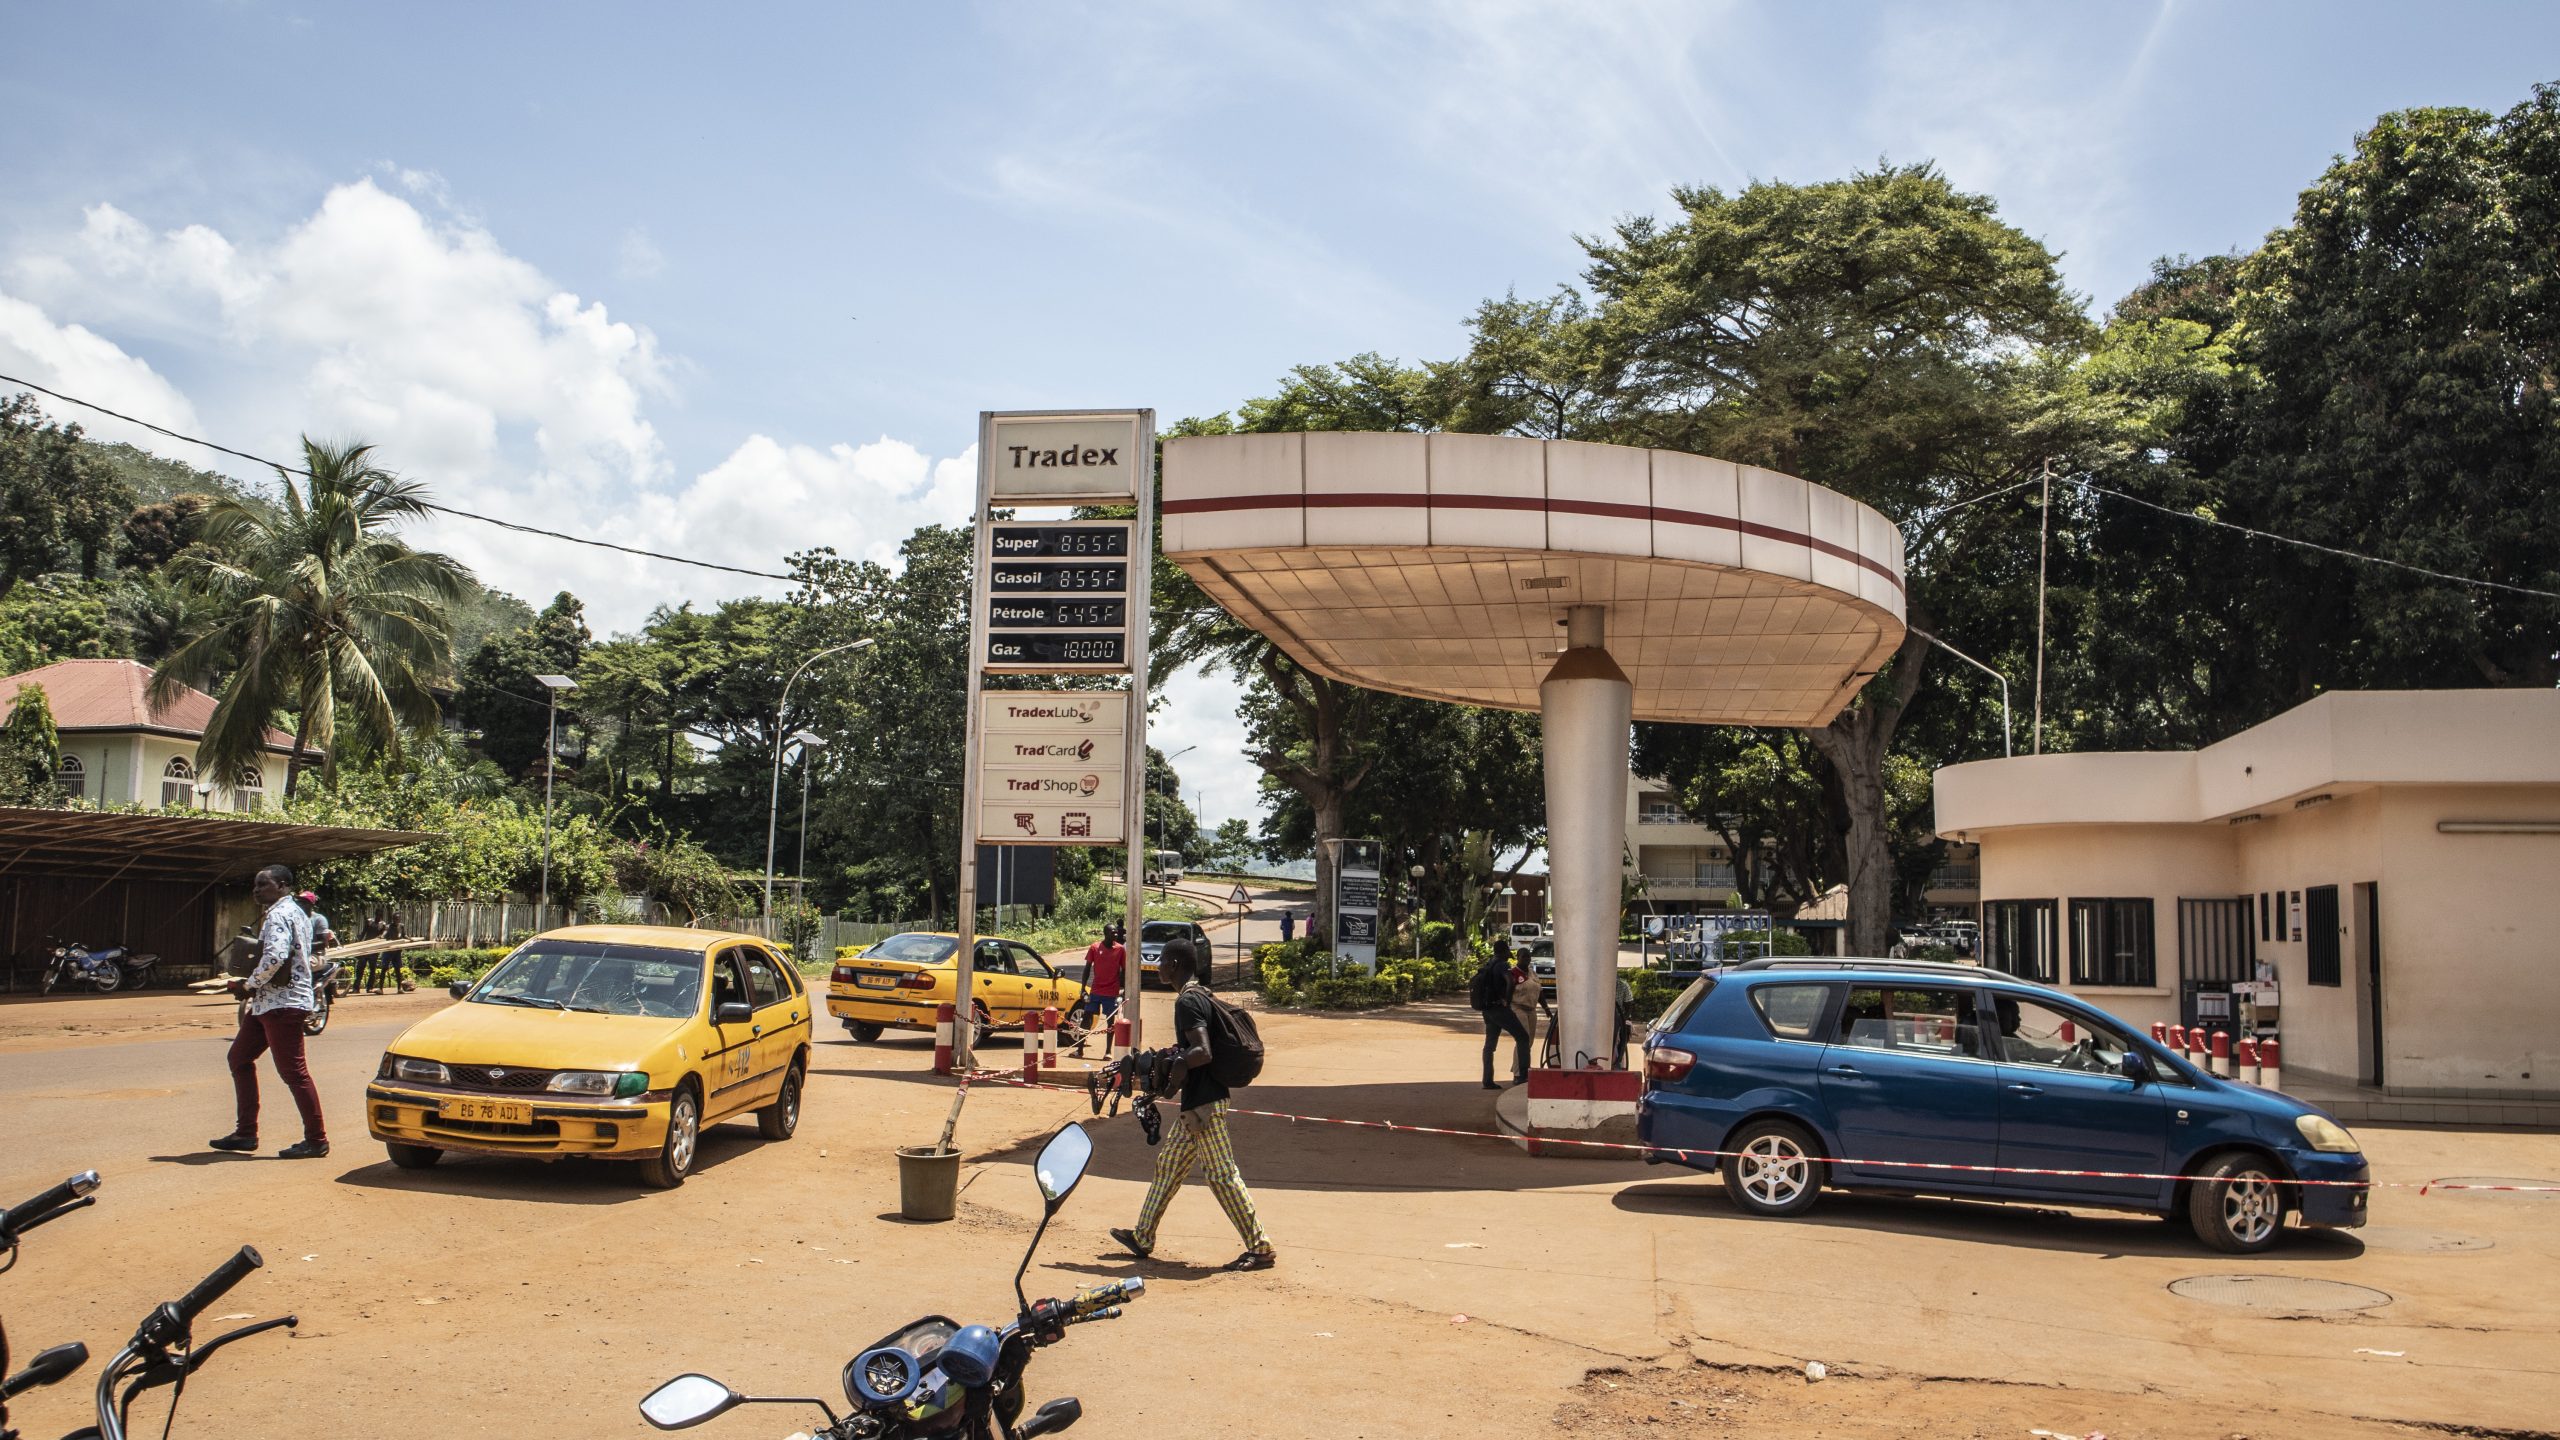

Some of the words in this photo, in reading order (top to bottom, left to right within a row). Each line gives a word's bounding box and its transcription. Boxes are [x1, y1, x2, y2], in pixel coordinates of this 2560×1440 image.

[1008, 444, 1119, 468] Tradex
[995, 537, 1039, 551] Super
[994, 572, 1042, 584] Gasoil
[992, 606, 1045, 619] Pétrole
[991, 643, 1021, 656] Gaz
[1007, 706, 1079, 718] TradexLub
[460, 1103, 474, 1117] BG
[480, 1105, 493, 1119] 78
[500, 1106, 519, 1120] ADI
